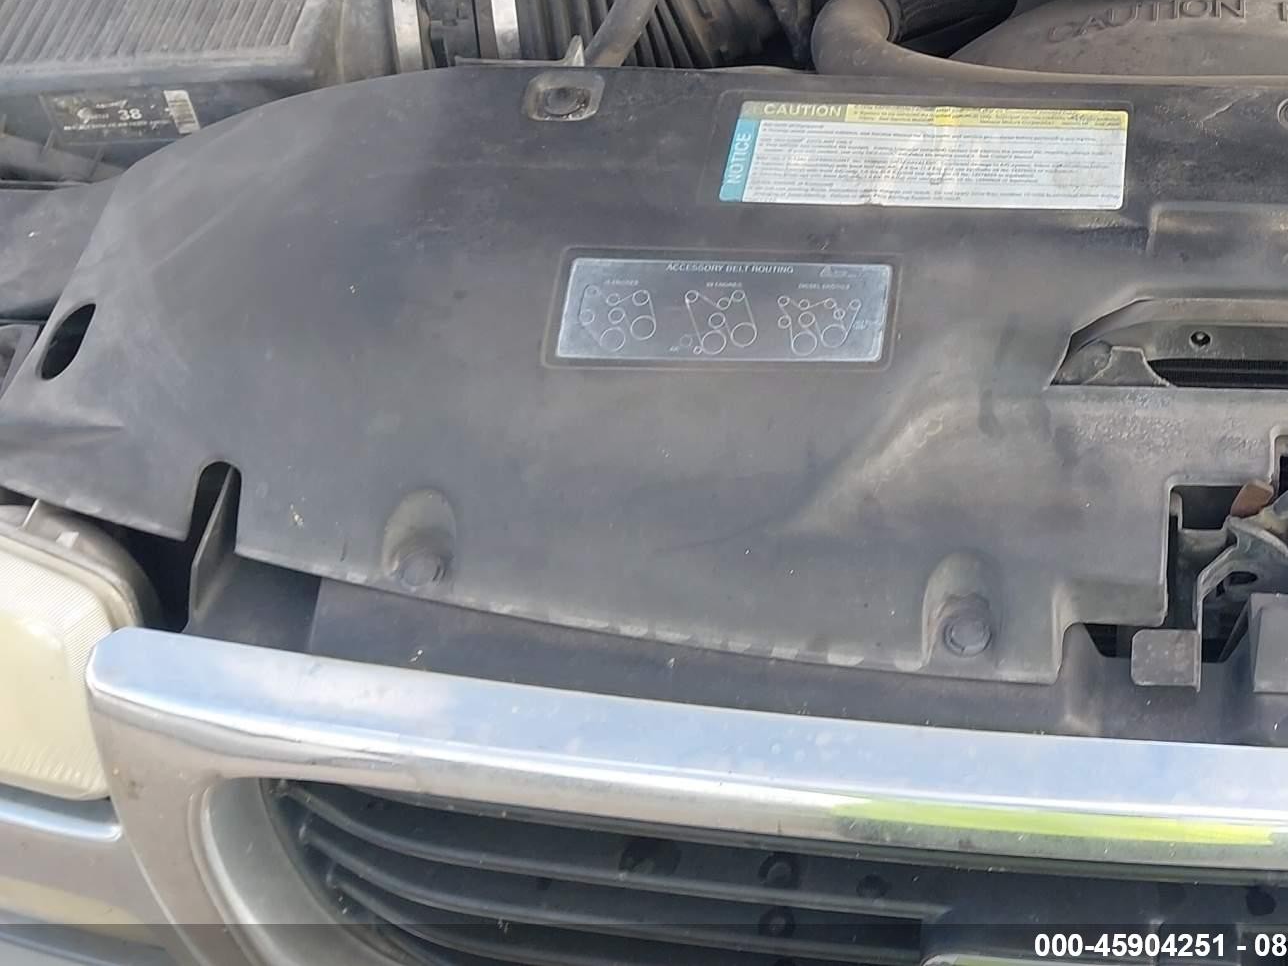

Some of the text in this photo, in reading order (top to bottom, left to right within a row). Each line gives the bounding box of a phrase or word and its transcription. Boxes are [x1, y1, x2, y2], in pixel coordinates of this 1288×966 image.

[117, 107, 143, 121] 38
[763, 103, 842, 118] CAUTION
[726, 132, 752, 185] NOTICE
